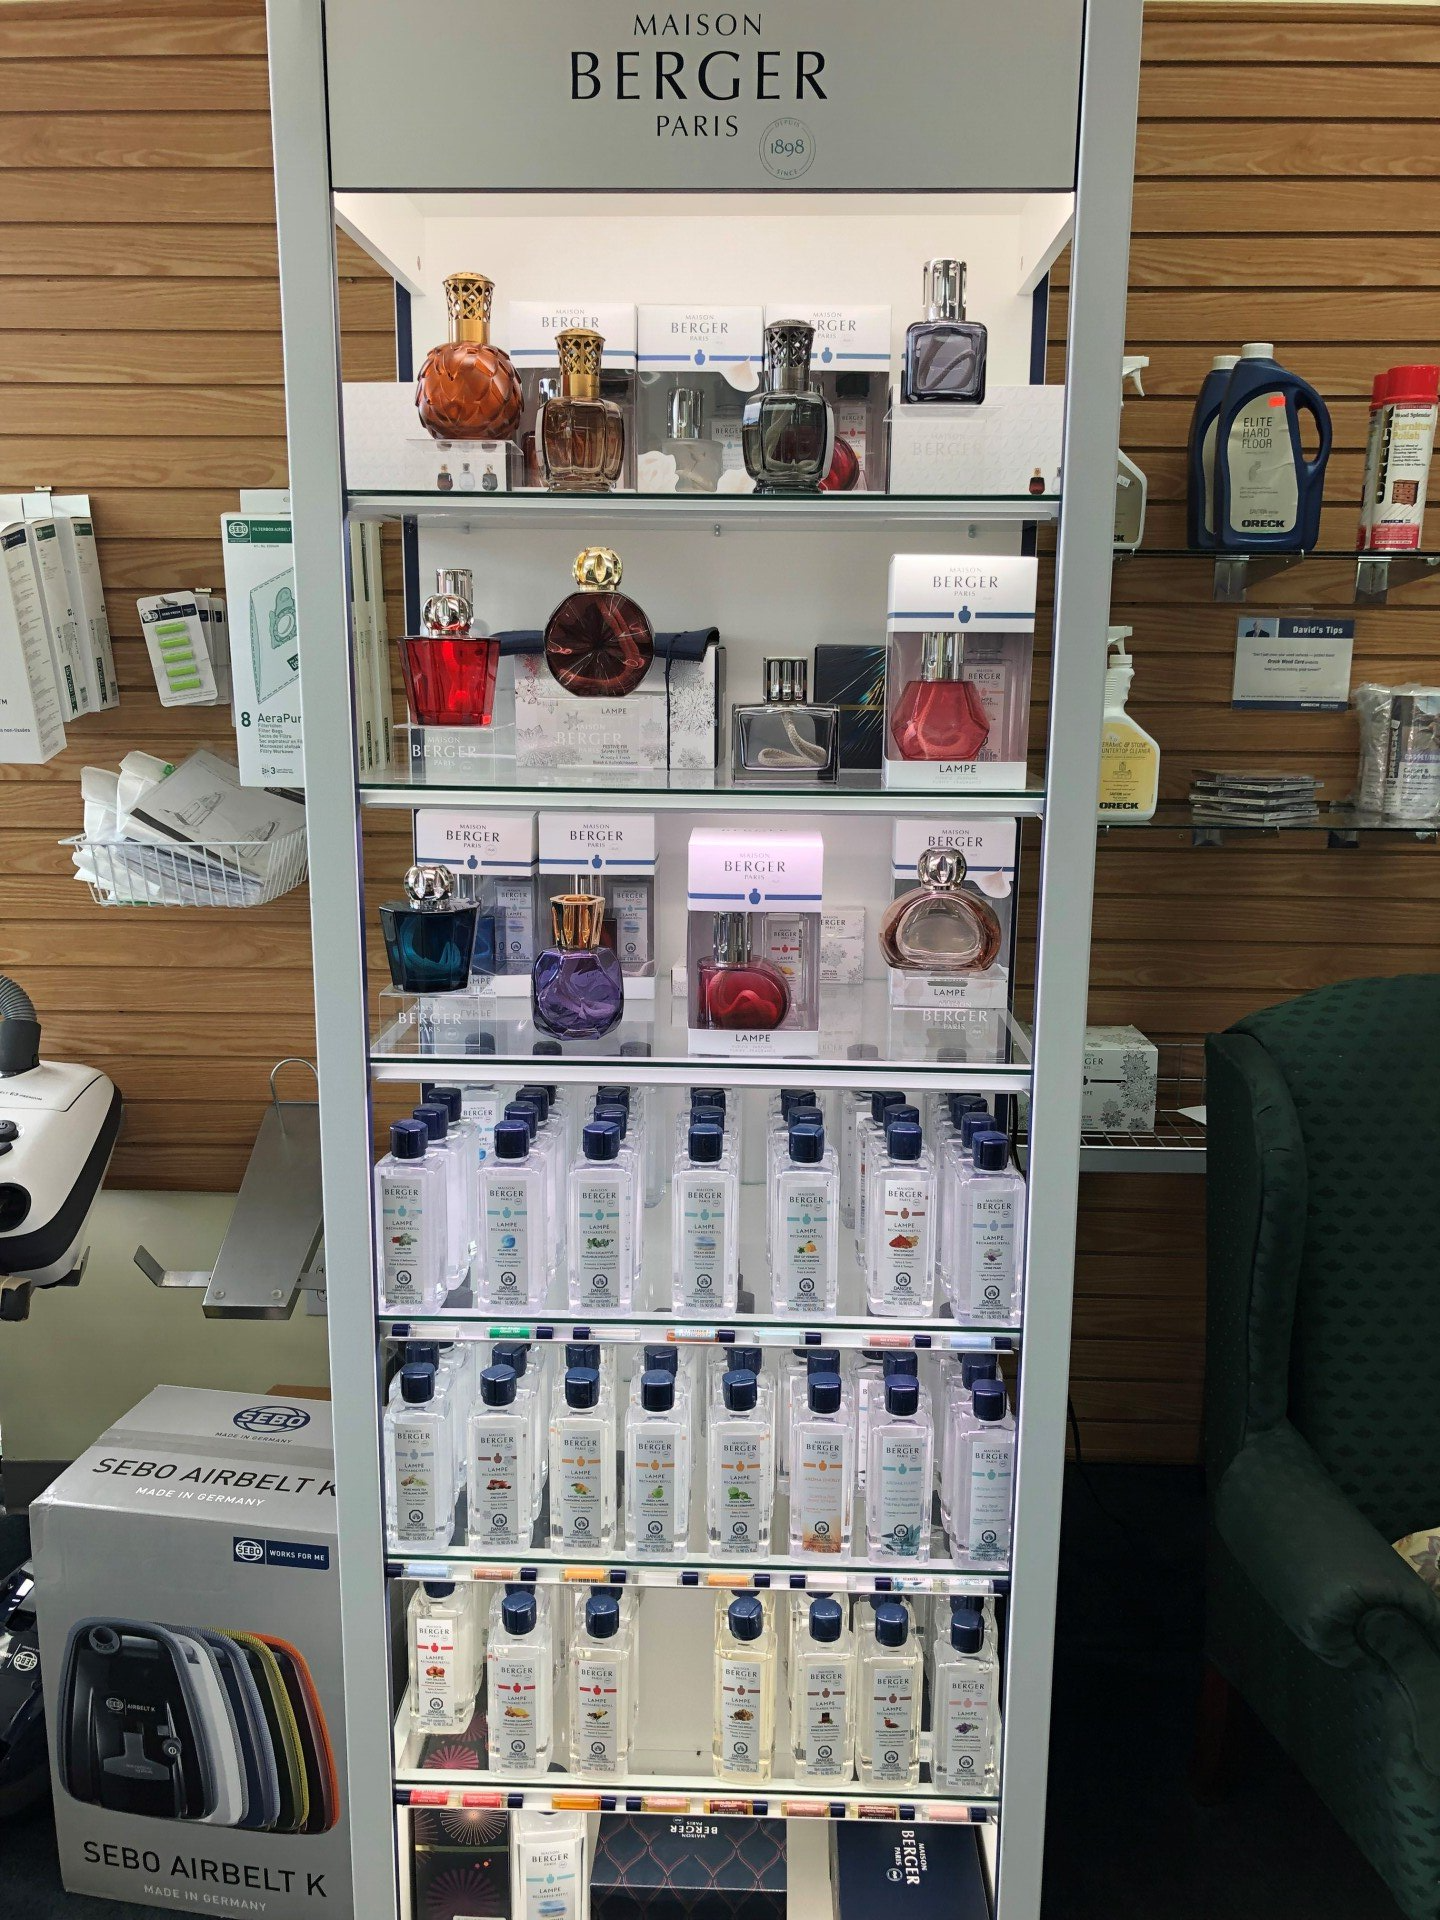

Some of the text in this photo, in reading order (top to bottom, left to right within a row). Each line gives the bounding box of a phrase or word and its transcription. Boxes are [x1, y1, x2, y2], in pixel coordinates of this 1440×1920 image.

[633, 13, 761, 36] MAISON
[571, 50, 828, 101] BERGER
[656, 115, 738, 137] PARIS
[770, 139, 805, 157] 1898
[776, 168, 798, 177] SINCE
[541, 316, 599, 328] BERGER
[809, 320, 856, 331] ERGER
[671, 322, 729, 334] BERGER
[1243, 417, 1273, 427] ELITE
[1243, 428, 1270, 438] HARD
[1242, 439, 1272, 449] FLOOR
[1242, 520, 1285, 528] ORECK
[933, 575, 999, 589] BERGER
[1292, 626, 1343, 635] David's Tips
[241, 711, 302, 727] 8 AeraPur
[557, 731, 621, 745] BERGER
[412, 744, 476, 757] BERGER
[270, 767, 276, 775] 3
[939, 764, 977, 774] LAMPE
[459, 823, 487, 831] MAISON
[446, 830, 500, 843] BERGER
[570, 830, 624, 841] BERGER
[928, 836, 983, 847] BERGER
[724, 860, 786, 873] BERGER
[934, 988, 966, 997] LAMPE
[398, 1012, 462, 1025] BERGER
[923, 1009, 988, 1022] BERGER
[735, 1034, 771, 1042] LAMPE
[1084, 1057, 1104, 1066] GER
[384, 1188, 419, 1197] BERGER
[489, 1189, 524, 1198] BERGER
[582, 1192, 617, 1200] BERGER
[687, 1192, 722, 1200] BERGER
[888, 1190, 923, 1199] BERGER
[789, 1196, 824, 1204] BERGER
[977, 1202, 1012, 1211] BERGER
[238, 1411, 306, 1427] SEBO
[251, 1436, 293, 1444] GERMANY
[397, 1432, 431, 1440] BERGER
[480, 1436, 514, 1444] BERGER
[564, 1439, 598, 1447] BERGER
[638, 1443, 672, 1451] BERGER
[723, 1444, 757, 1452] BERGER
[806, 1444, 840, 1452] BERGER
[886, 1447, 920, 1455] BERGER
[975, 1452, 1009, 1460] BERGER
[92, 1458, 337, 1497] SEBO AIRBELT K
[135, 1486, 266, 1507] MADE IN GERMANY
[237, 1545, 261, 1555] SEBO
[269, 1549, 296, 1558] WORKS
[297, 1552, 312, 1560] FOR
[419, 1627, 450, 1636] BERGER
[500, 1666, 533, 1675] BERGER
[581, 1669, 614, 1678] BERGER
[725, 1668, 758, 1678] BERGER
[810, 1672, 843, 1681] BERGER
[877, 1677, 911, 1687] BERGER
[952, 1682, 985, 1691] BERGER
[731, 1697, 751, 1705] LAMPE
[127, 1704, 151, 1712] AIRBELT
[956, 1710, 978, 1718] LAMPE
[670, 1825, 718, 1835] BERGER
[532, 1853, 569, 1863] BERGER
[894, 1847, 903, 1866] PARIS
[901, 1830, 920, 1885] BERGER
[918, 1842, 928, 1871] MAISON
[83, 1840, 328, 1898] SEBO AIRBELT K
[143, 1884, 267, 1913] MADE IN GERMANY
